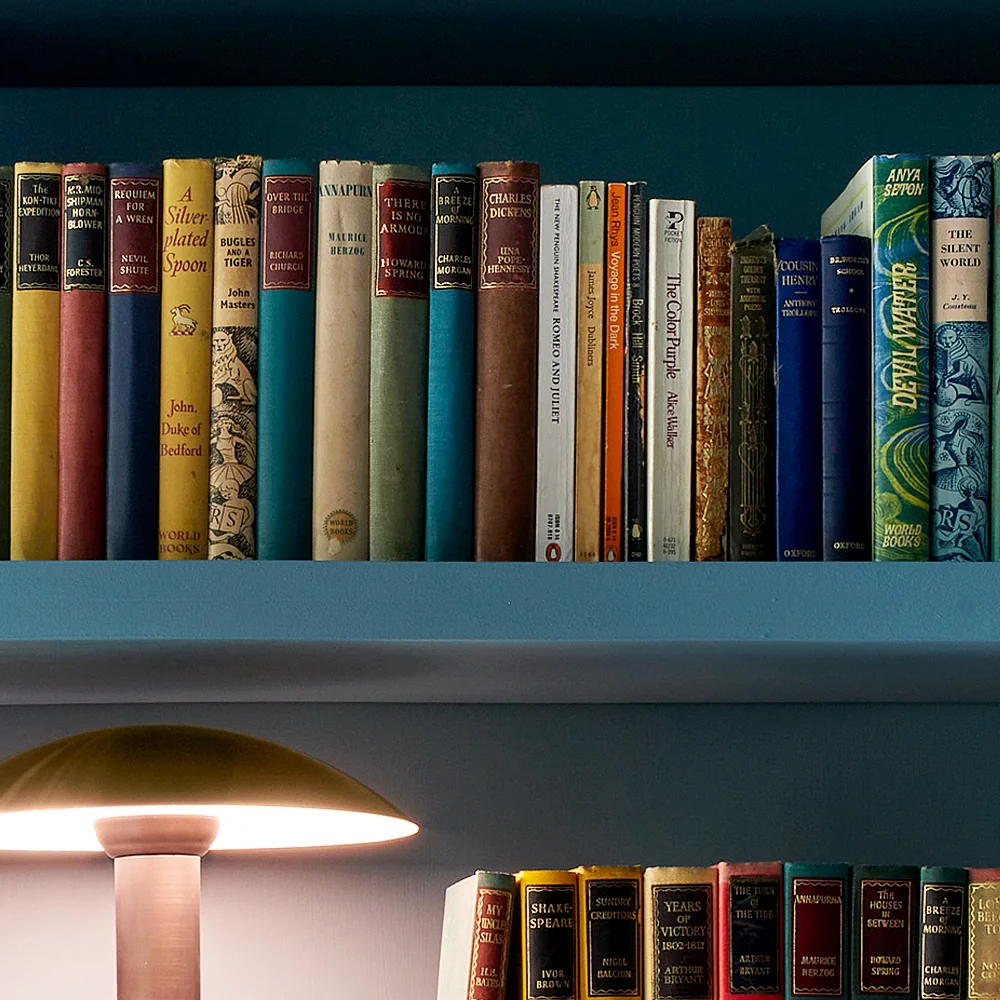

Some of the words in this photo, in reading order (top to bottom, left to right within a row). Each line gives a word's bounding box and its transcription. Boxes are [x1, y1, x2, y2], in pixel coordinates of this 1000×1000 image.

[887, 169, 921, 182] ANYA
[115, 190, 155, 200] REQUIEM
[178, 187, 192, 202] A
[884, 184, 924, 196] SETON
[23, 197, 57, 205] KON-TIKI
[489, 194, 531, 204] CHARLES
[612, 192, 621, 217] Jean
[127, 203, 144, 211] FOR
[490, 208, 531, 218] DICKENS
[126, 215, 153, 224] WREN
[611, 222, 621, 246] Rhys
[948, 230, 972, 238] THE
[163, 229, 209, 252] plated
[221, 238, 255, 246] BUGLES
[941, 244, 980, 253] SILENT
[122, 255, 148, 263] NEVIL
[224, 258, 252, 267] TIGER
[940, 258, 981, 267] WORLD
[120, 266, 149, 275] SHUTE
[163, 253, 207, 278] Spoon
[608, 251, 621, 289] Voyage
[588, 271, 596, 294] James
[667, 274, 681, 298] The
[782, 276, 817, 286] HENRY
[228, 288, 250, 297] John
[610, 293, 620, 302] in
[220, 300, 255, 309] Masters
[587, 297, 595, 318] Joyce
[892, 262, 917, 343] WATER
[610, 305, 620, 322] the
[666, 301, 681, 336] Color
[552, 317, 561, 358] ROMEO
[610, 327, 620, 349] Dark
[664, 338, 681, 380] Purple
[552, 361, 560, 385] AND
[892, 346, 917, 409] DEVIL
[550, 387, 560, 424] JULIET
[667, 391, 678, 415] Alice
[667, 416, 678, 449] Walker
[160, 444, 202, 456] Bedford
[884, 524, 922, 536] WORLD
[883, 536, 921, 548] BOOKS
[664, 901, 702, 912] YEARS
[661, 926, 706, 936] VICTORY
[662, 941, 704, 951] 1802-1812
[542, 970, 564, 979] IVOR
[536, 980, 570, 988] BROWN
